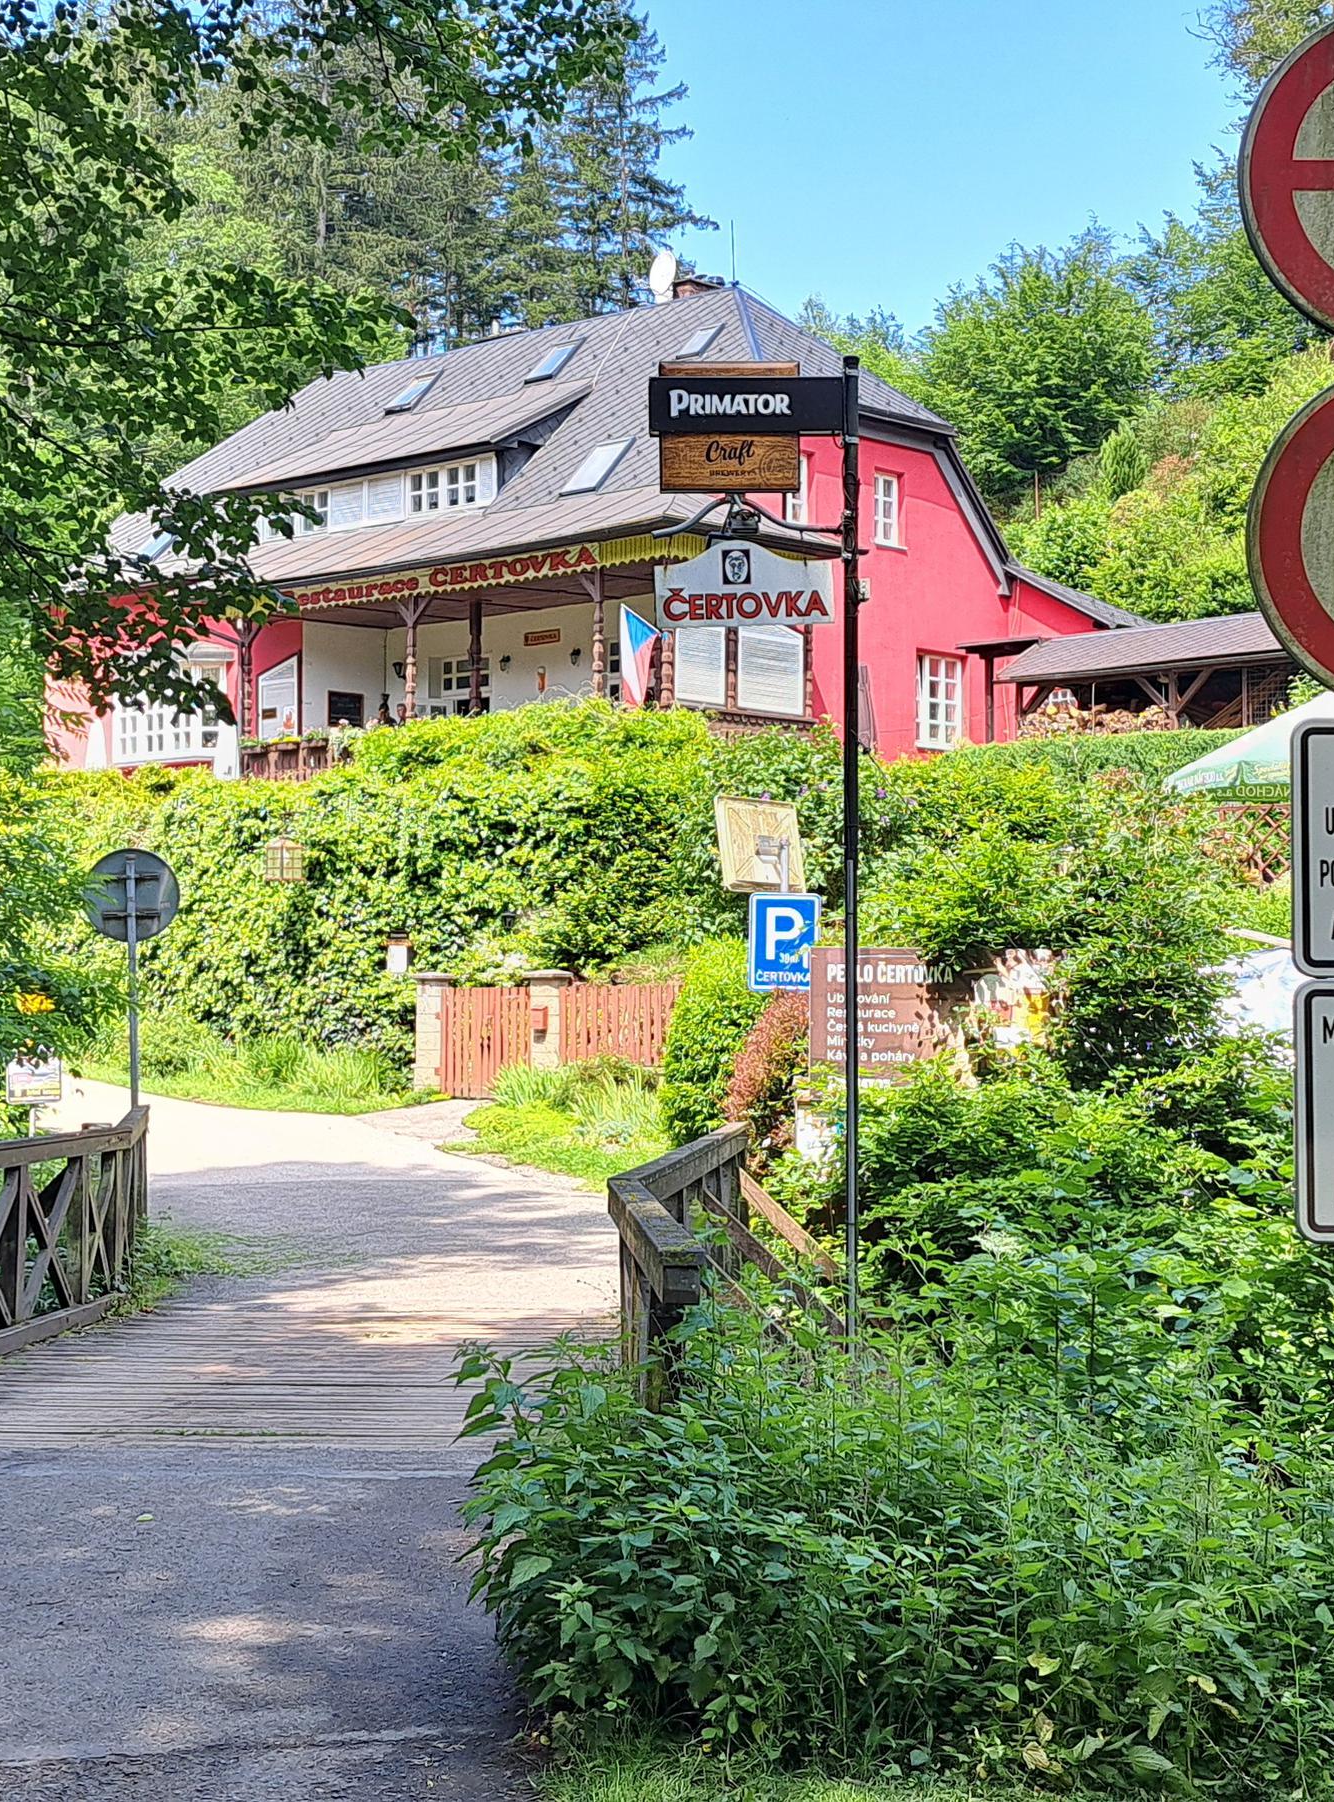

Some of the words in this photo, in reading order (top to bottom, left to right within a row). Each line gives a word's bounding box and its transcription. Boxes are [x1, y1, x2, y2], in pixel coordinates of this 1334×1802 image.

[705, 440, 755, 466] Craft
[283, 576, 420, 608] estaurace
[429, 544, 597, 587] ČERTOVKA
[663, 588, 829, 621] ČERTOVKA
[766, 907, 803, 960] P
[827, 963, 873, 982] PELO
[877, 961, 953, 983] ČERTOVKA
[827, 993, 890, 1004] Ubování
[827, 1019, 864, 1031] Čeá
[868, 1022, 920, 1035] kuchyně
[871, 1050, 915, 1062] poháry
